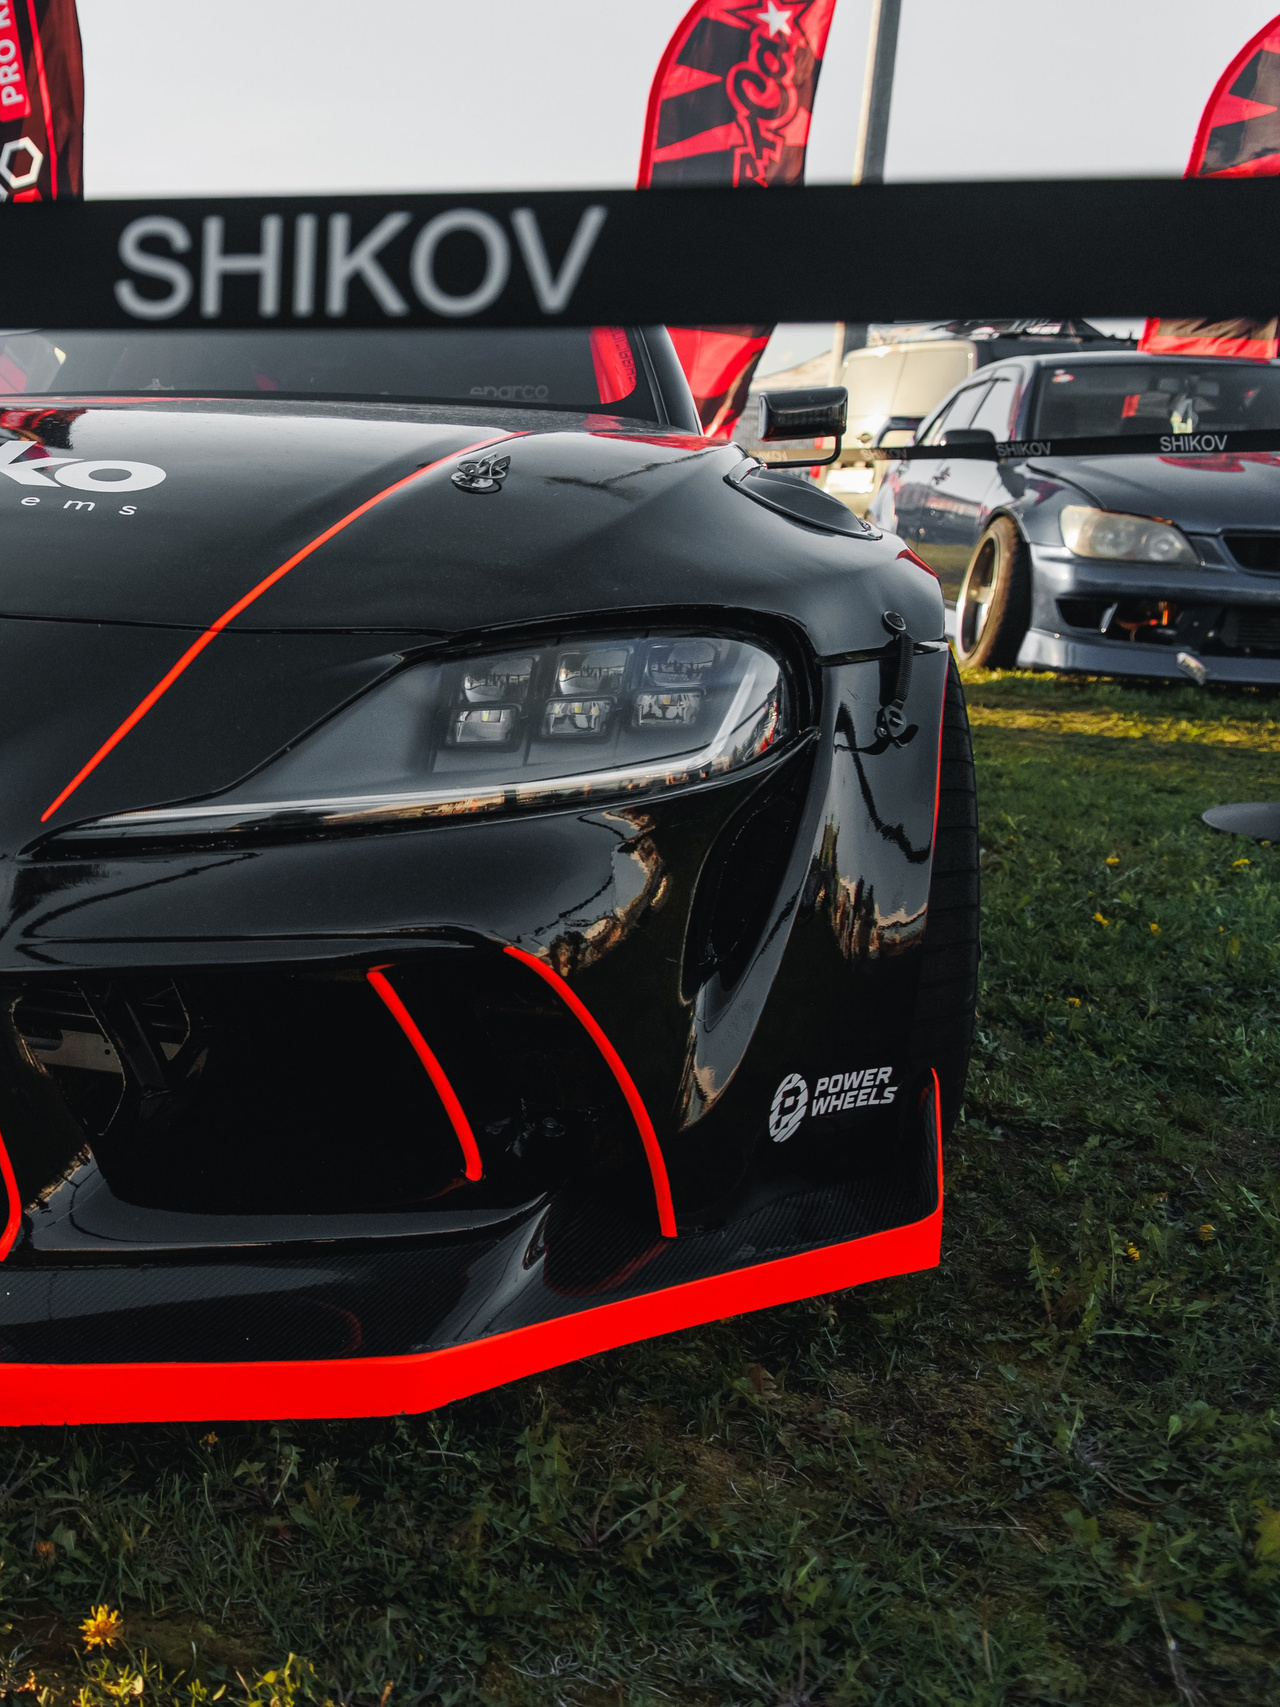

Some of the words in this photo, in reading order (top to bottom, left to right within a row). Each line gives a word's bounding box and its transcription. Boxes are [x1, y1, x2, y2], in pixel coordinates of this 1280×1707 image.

[115, 208, 609, 322] SHIKOV
[995, 441, 1053, 458] SHIKOV
[1159, 433, 1229, 453] SHIKOV
[814, 1066, 893, 1097] POWER
[811, 1086, 899, 1117] WHEELS
